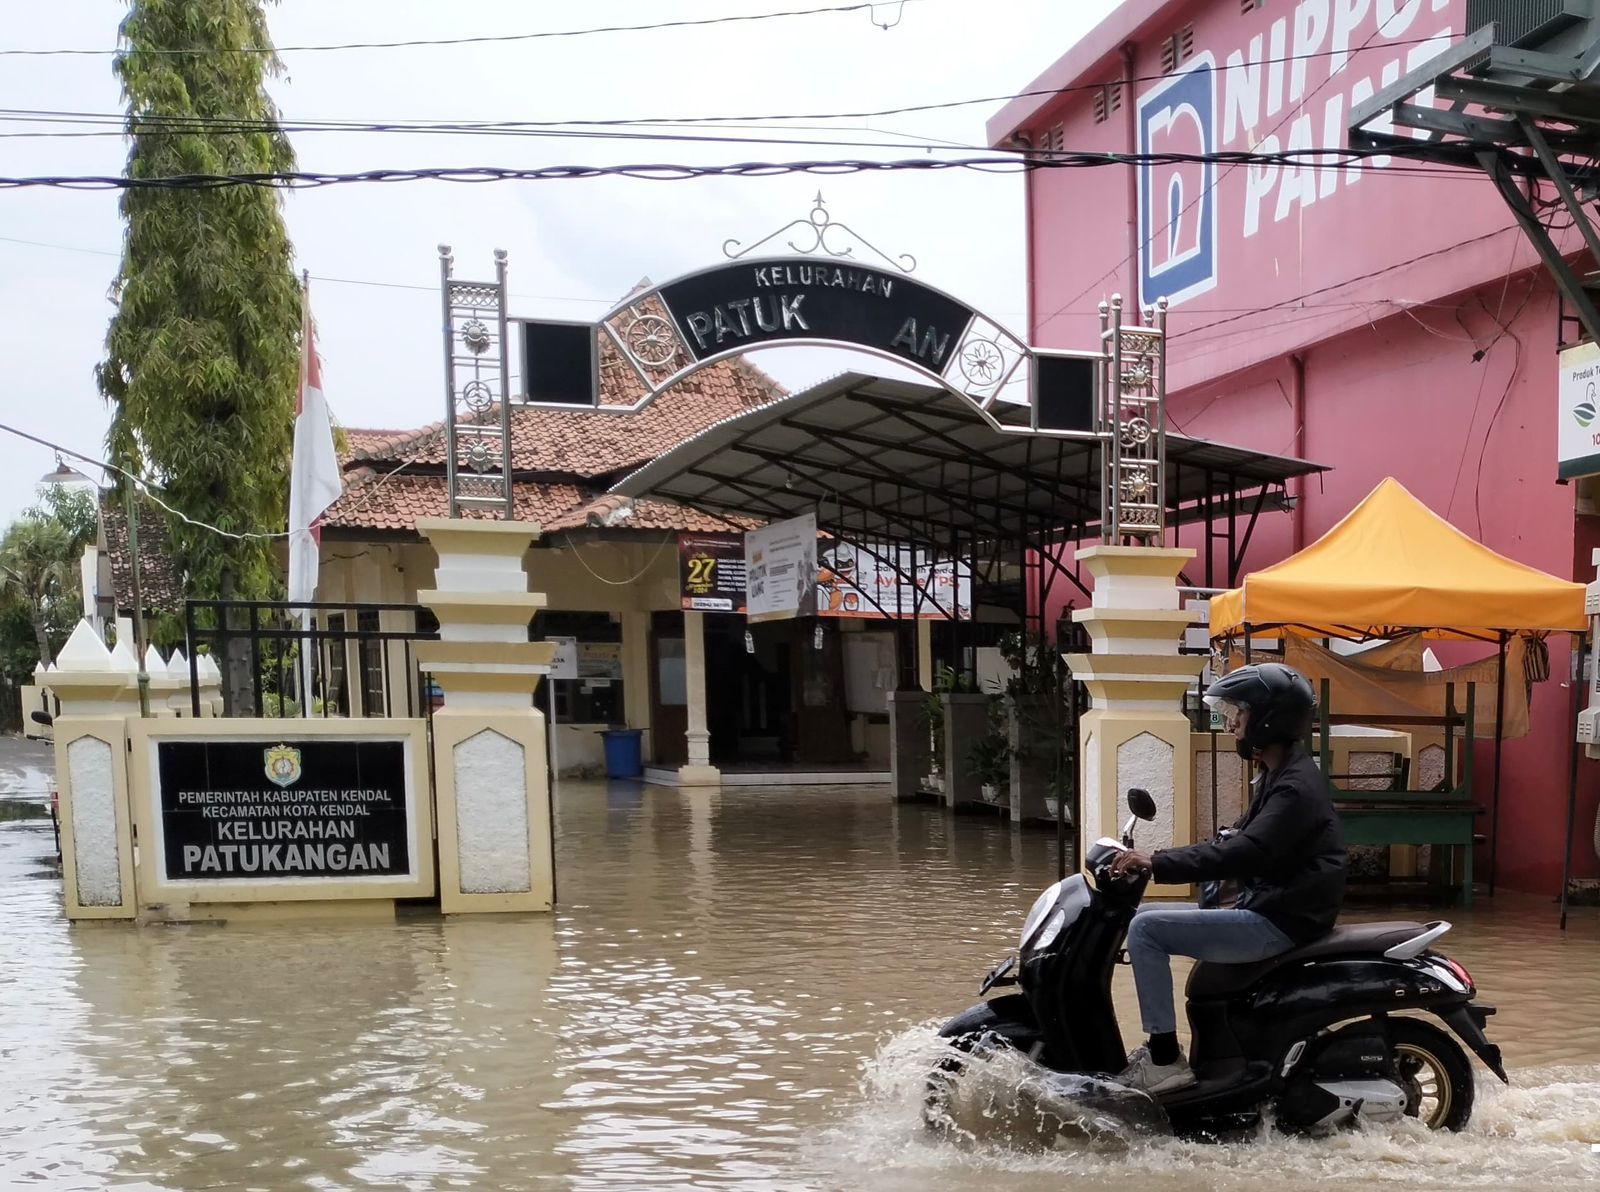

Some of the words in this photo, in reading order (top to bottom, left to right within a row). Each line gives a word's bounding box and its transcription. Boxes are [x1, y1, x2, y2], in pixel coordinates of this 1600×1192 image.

[754, 265, 895, 298] KELURAHAN
[1572, 367, 1594, 382] Produk
[687, 559, 716, 583] 27
[179, 791, 260, 804] PEMERINTAH
[262, 790, 338, 803] KABUPATEN
[341, 789, 392, 802] KENDAL
[202, 805, 280, 818] KECAMATAN
[283, 805, 316, 817] KOTA
[319, 804, 371, 816] KENDAL
[217, 820, 355, 840] KELURAHAN
[183, 842, 391, 872] PATUKANGAN
